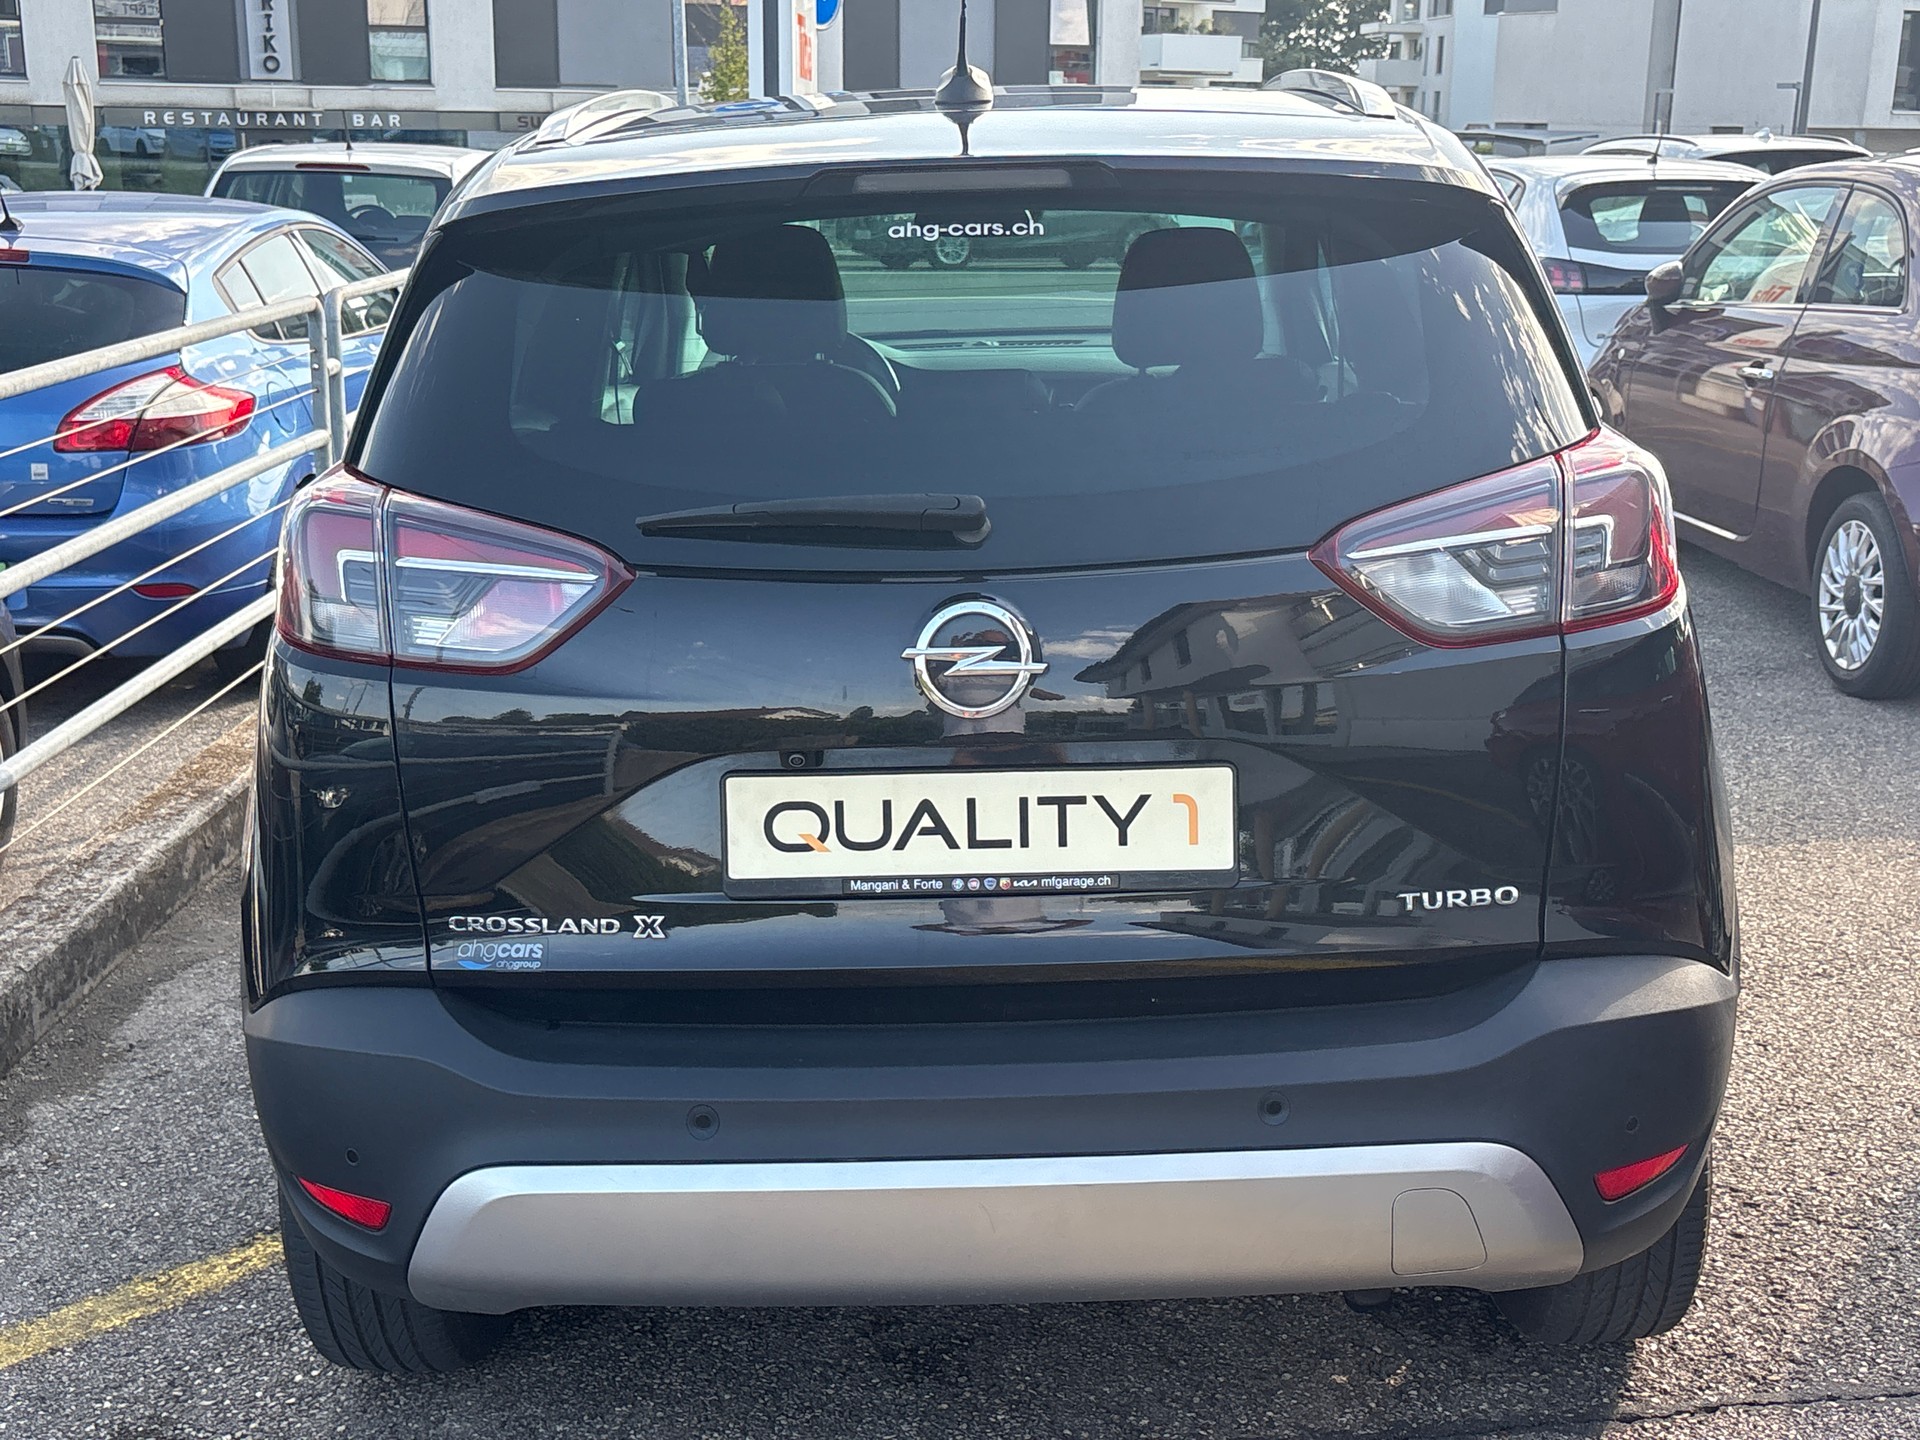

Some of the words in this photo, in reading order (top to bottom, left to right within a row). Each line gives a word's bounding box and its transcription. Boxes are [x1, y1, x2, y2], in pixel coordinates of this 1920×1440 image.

[143, 111, 324, 127] RESTAURANT
[352, 113, 402, 128] BAR
[888, 221, 1045, 242] ahg-cars.ch
[764, 794, 1152, 853] QUALITY
[1173, 793, 1198, 846] 1
[850, 879, 899, 893] Mangani
[902, 879, 911, 890] &
[913, 878, 944, 890] Forte
[1041, 875, 1112, 889] mfgarage.ch
[1396, 886, 1519, 911] TURBO
[448, 915, 621, 934] CROSSLAND
[632, 915, 667, 939] X
[457, 939, 544, 962] ahgcars
[495, 960, 542, 970] ahggroup
